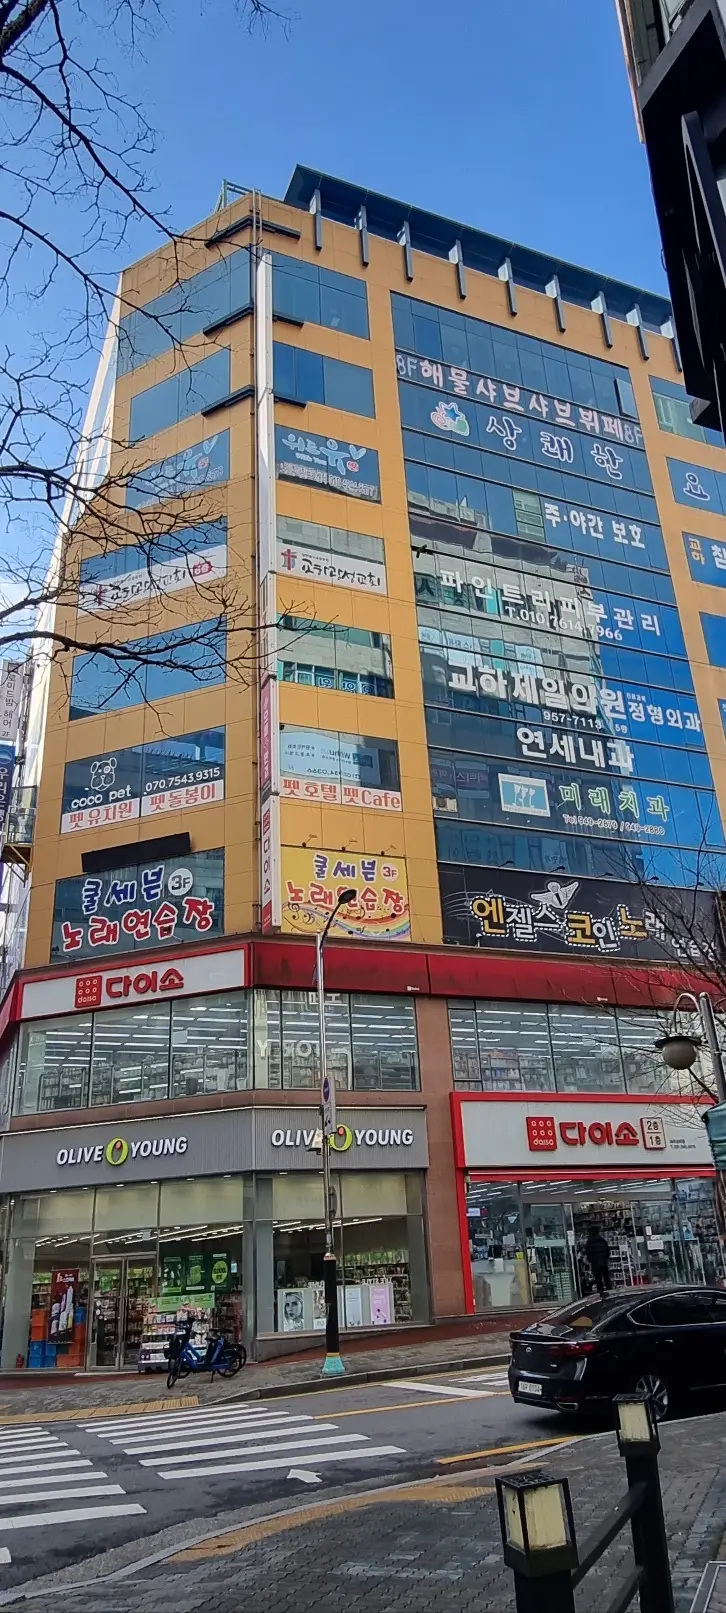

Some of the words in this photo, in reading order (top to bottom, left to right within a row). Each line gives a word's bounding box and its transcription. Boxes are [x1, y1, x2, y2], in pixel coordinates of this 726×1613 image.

[396, 354, 418, 377] 8F
[420, 358, 624, 442] 해물샤브샤브뷔페
[486, 415, 623, 480] 상쾌한
[683, 472, 710, 501] 요
[612, 519, 646, 549] 보호
[439, 569, 662, 637] 파인트리피부관리
[448, 664, 627, 720] 교하제일의원
[543, 710, 603, 730] 957-7113
[628, 701, 701, 732] 정형외과
[516, 726, 636, 774] 연세내과
[145, 767, 221, 793] 070.7543.9315
[304, 781, 338, 802] 호텔
[71, 793, 103, 809] coco
[109, 784, 132, 803] pet
[88, 801, 133, 827] 유치원
[168, 783, 217, 809] 돌봄이
[558, 782, 671, 824] 미래치과
[314, 853, 377, 882] 쿨세븐
[382, 865, 398, 878] 3F
[82, 864, 165, 915] 쿨세븐
[170, 873, 191, 892] 3F
[61, 896, 216, 953] 노래연습장
[105, 967, 185, 998] 다이소
[77, 995, 97, 1004] daiso
[271, 1129, 317, 1147] OLIV
[354, 1129, 414, 1146] YOUNG
[558, 1121, 640, 1146] 다이소
[646, 1120, 659, 1131] 2층
[56, 1145, 104, 1165] OLIVE
[130, 1136, 188, 1158] YOUNG
[533, 1138, 554, 1146] daiso
[649, 1136, 662, 1146] 1층
